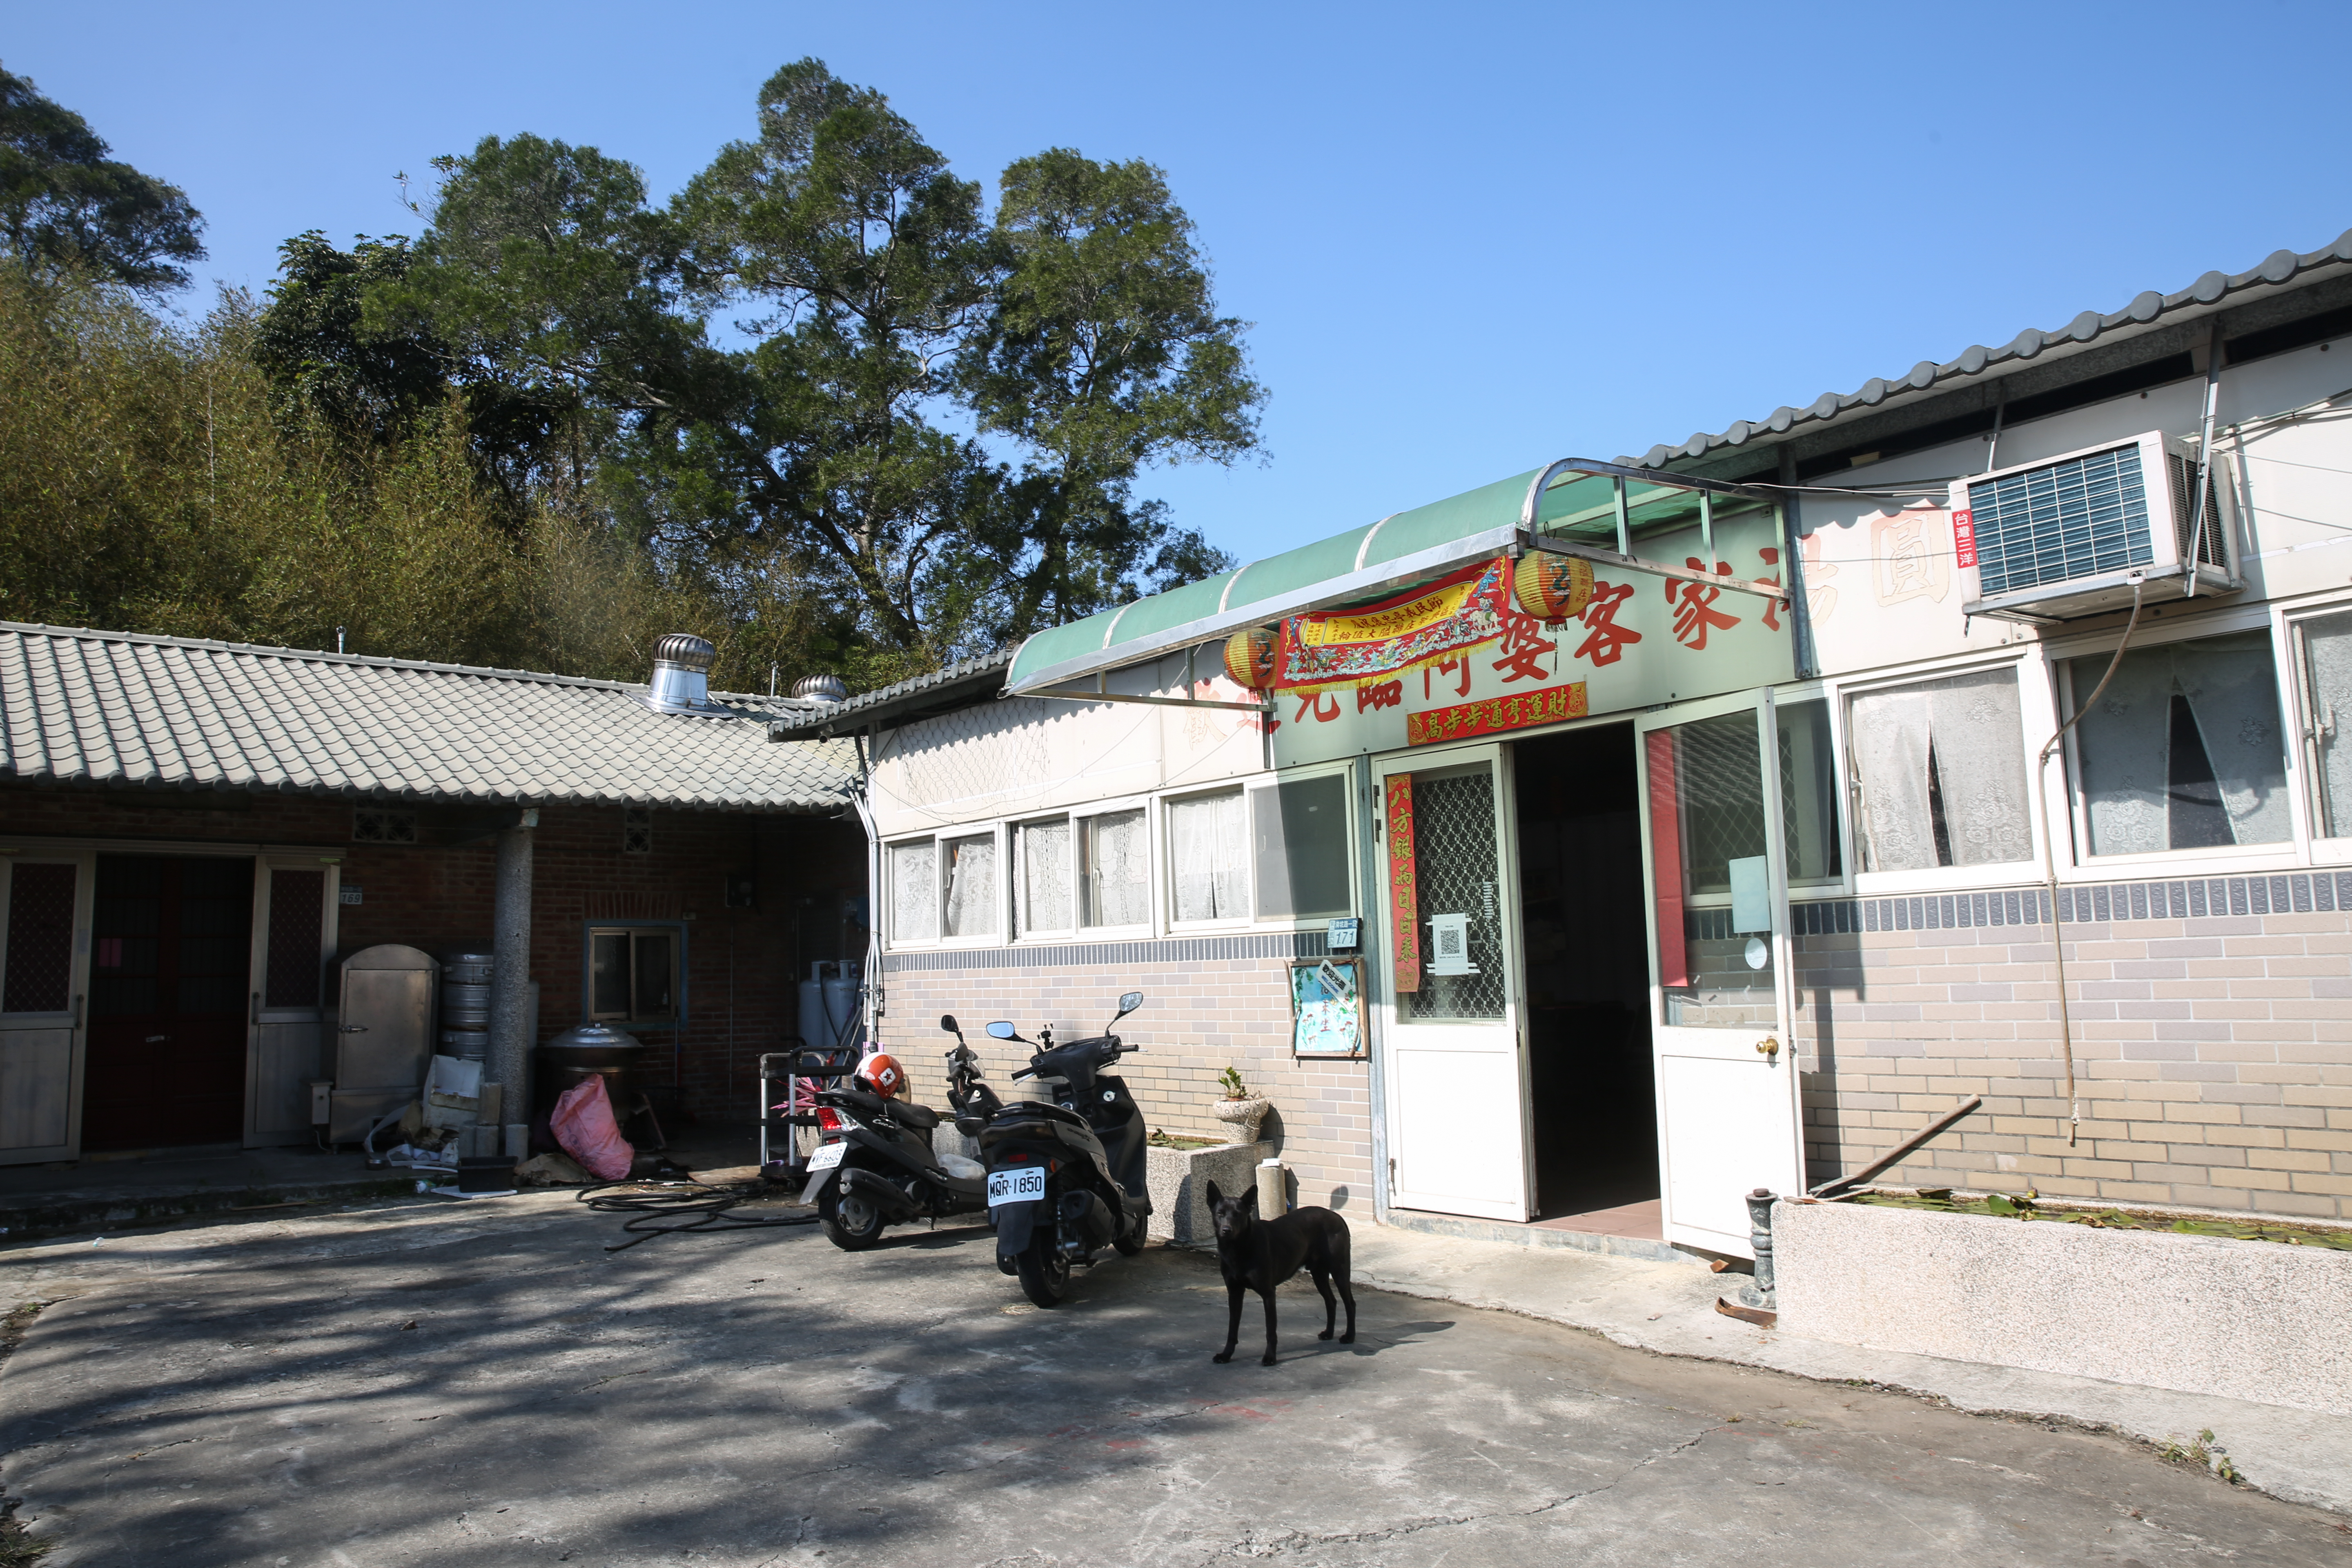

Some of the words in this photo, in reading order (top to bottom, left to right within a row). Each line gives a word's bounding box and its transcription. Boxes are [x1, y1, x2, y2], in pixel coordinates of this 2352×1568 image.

[1954, 513, 1974, 566] 台灣三洋
[1425, 686, 1568, 739] 財運亨通步步高
[342, 893, 361, 903] 169
[1336, 931, 1354, 944] 171
[1321, 974, 1339, 994] WELCOME
[1322, 964, 1347, 991] 歡迎光臨
[989, 1176, 1042, 1199] MQR-1850
